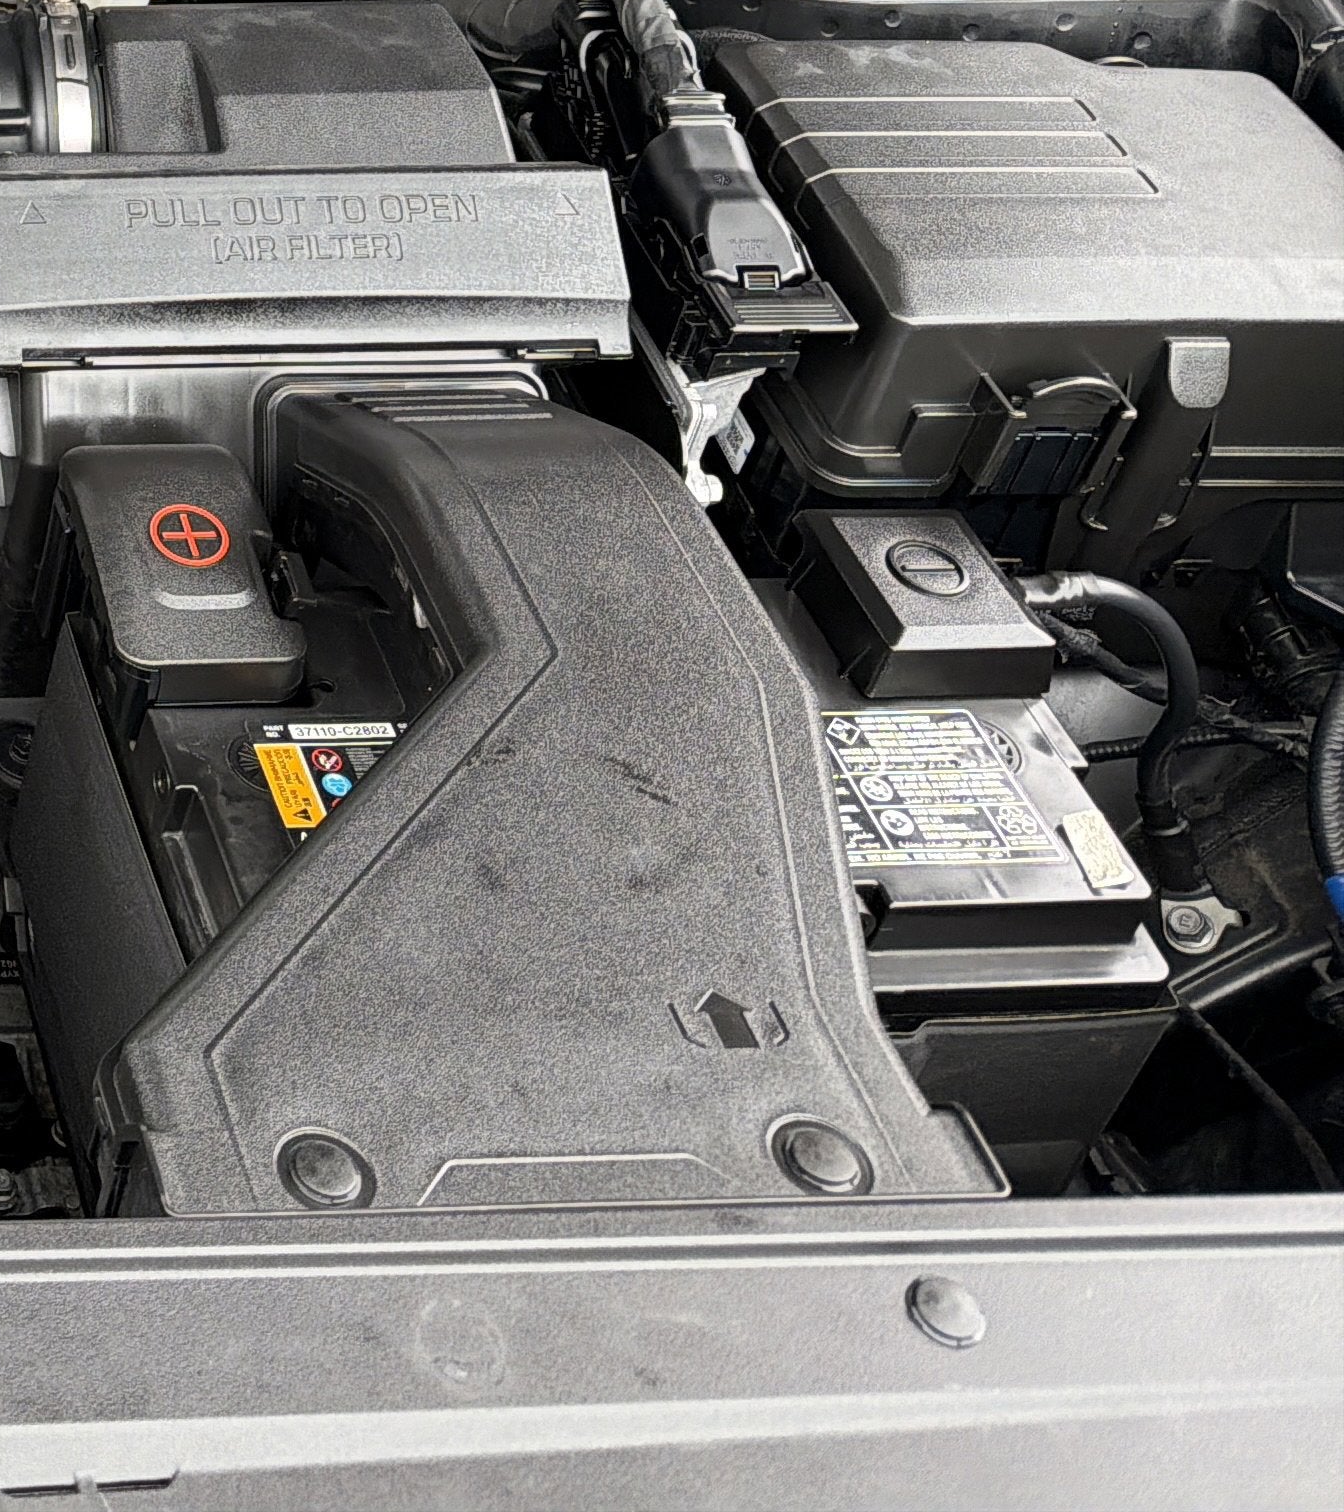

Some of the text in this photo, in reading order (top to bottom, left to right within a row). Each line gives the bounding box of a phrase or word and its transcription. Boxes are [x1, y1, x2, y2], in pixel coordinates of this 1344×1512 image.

[124, 193, 480, 228] PULL OUT TO OPEN
[295, 725, 390, 737] 37110-C2802
